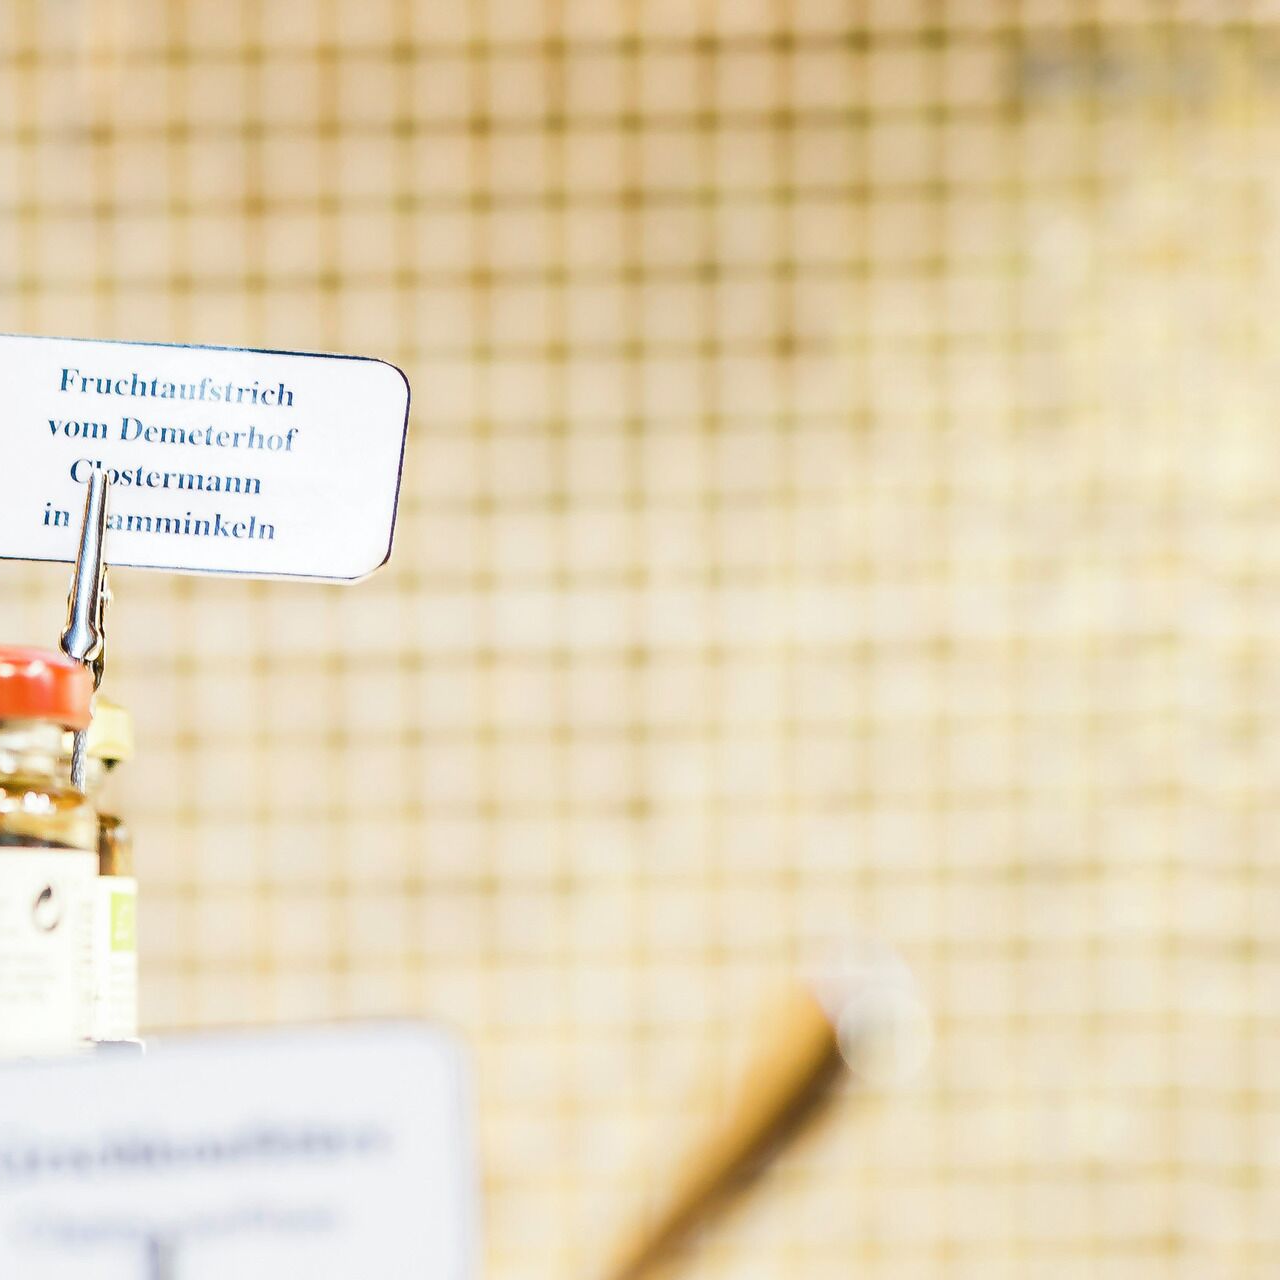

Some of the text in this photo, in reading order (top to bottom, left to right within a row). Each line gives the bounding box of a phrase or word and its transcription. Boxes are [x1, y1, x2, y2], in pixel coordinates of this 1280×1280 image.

[59, 367, 294, 407] Fruchtaufstrich
[48, 417, 299, 452] vom Demeterhof
[70, 459, 261, 495] Costermann
[43, 502, 275, 540] in amminkeln
